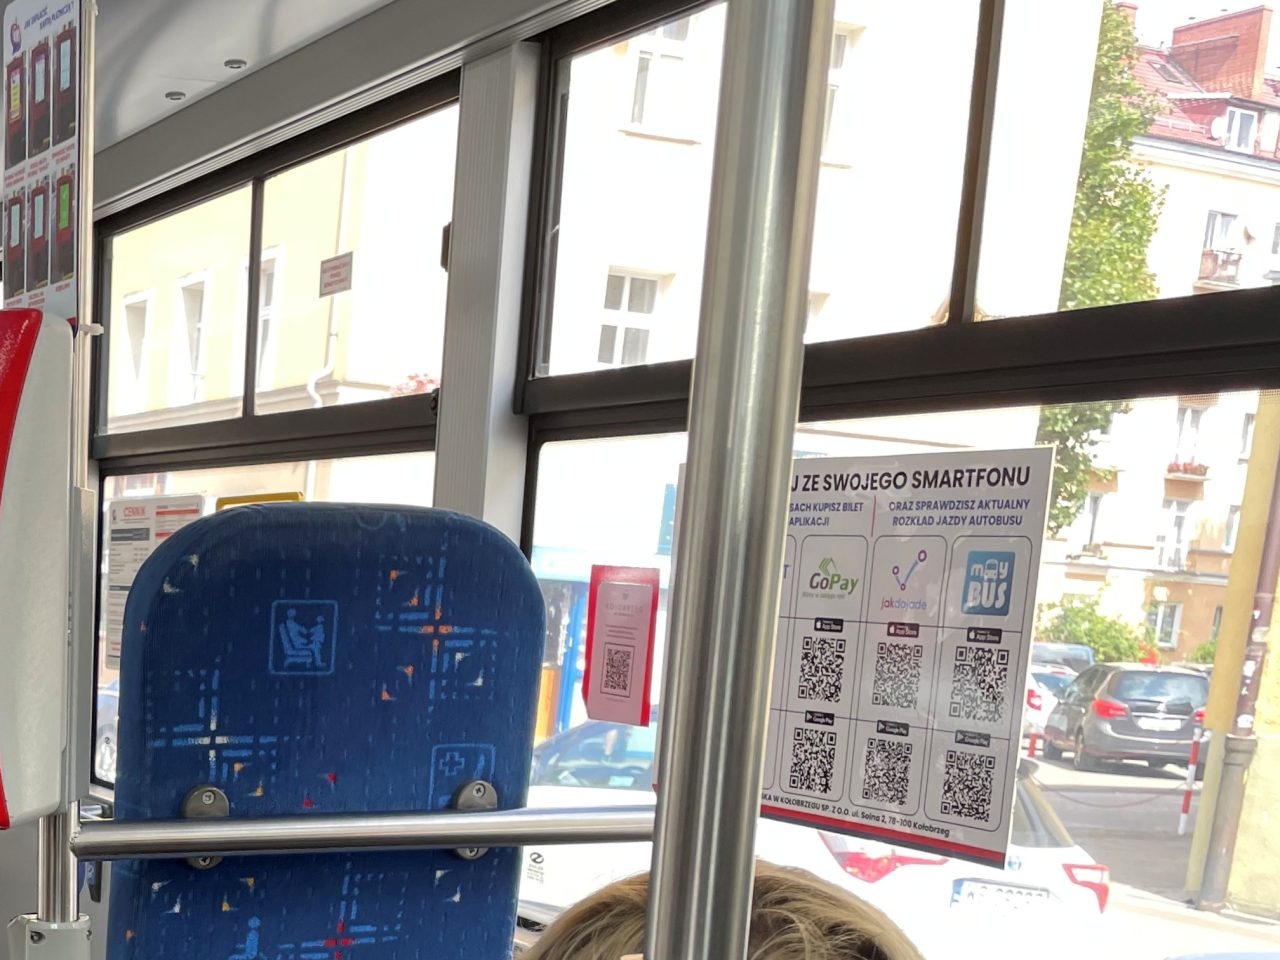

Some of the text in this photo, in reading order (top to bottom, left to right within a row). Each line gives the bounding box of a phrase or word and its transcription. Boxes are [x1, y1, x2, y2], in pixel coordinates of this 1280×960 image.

[802, 475, 819, 492] ZE
[823, 471, 908, 491] SWOJEGO
[911, 466, 1031, 489] SMARTFONU
[789, 502, 864, 512] SACH KUPISZ BILET
[888, 499, 1031, 512] ORAZ SPRAWDZISZ AKTUALNY
[892, 515, 1023, 526] ROZKŁAD JAZDY AUTOBUSU
[809, 572, 859, 595] GoPay
[880, 596, 928, 612] jakdojade
[967, 581, 1008, 609] BUS
[780, 797, 820, 810] KOŁOBRZEGU
[861, 812, 880, 822] Solna
[888, 816, 912, 828] 78-100
[913, 821, 950, 838] Kołobrzeg
